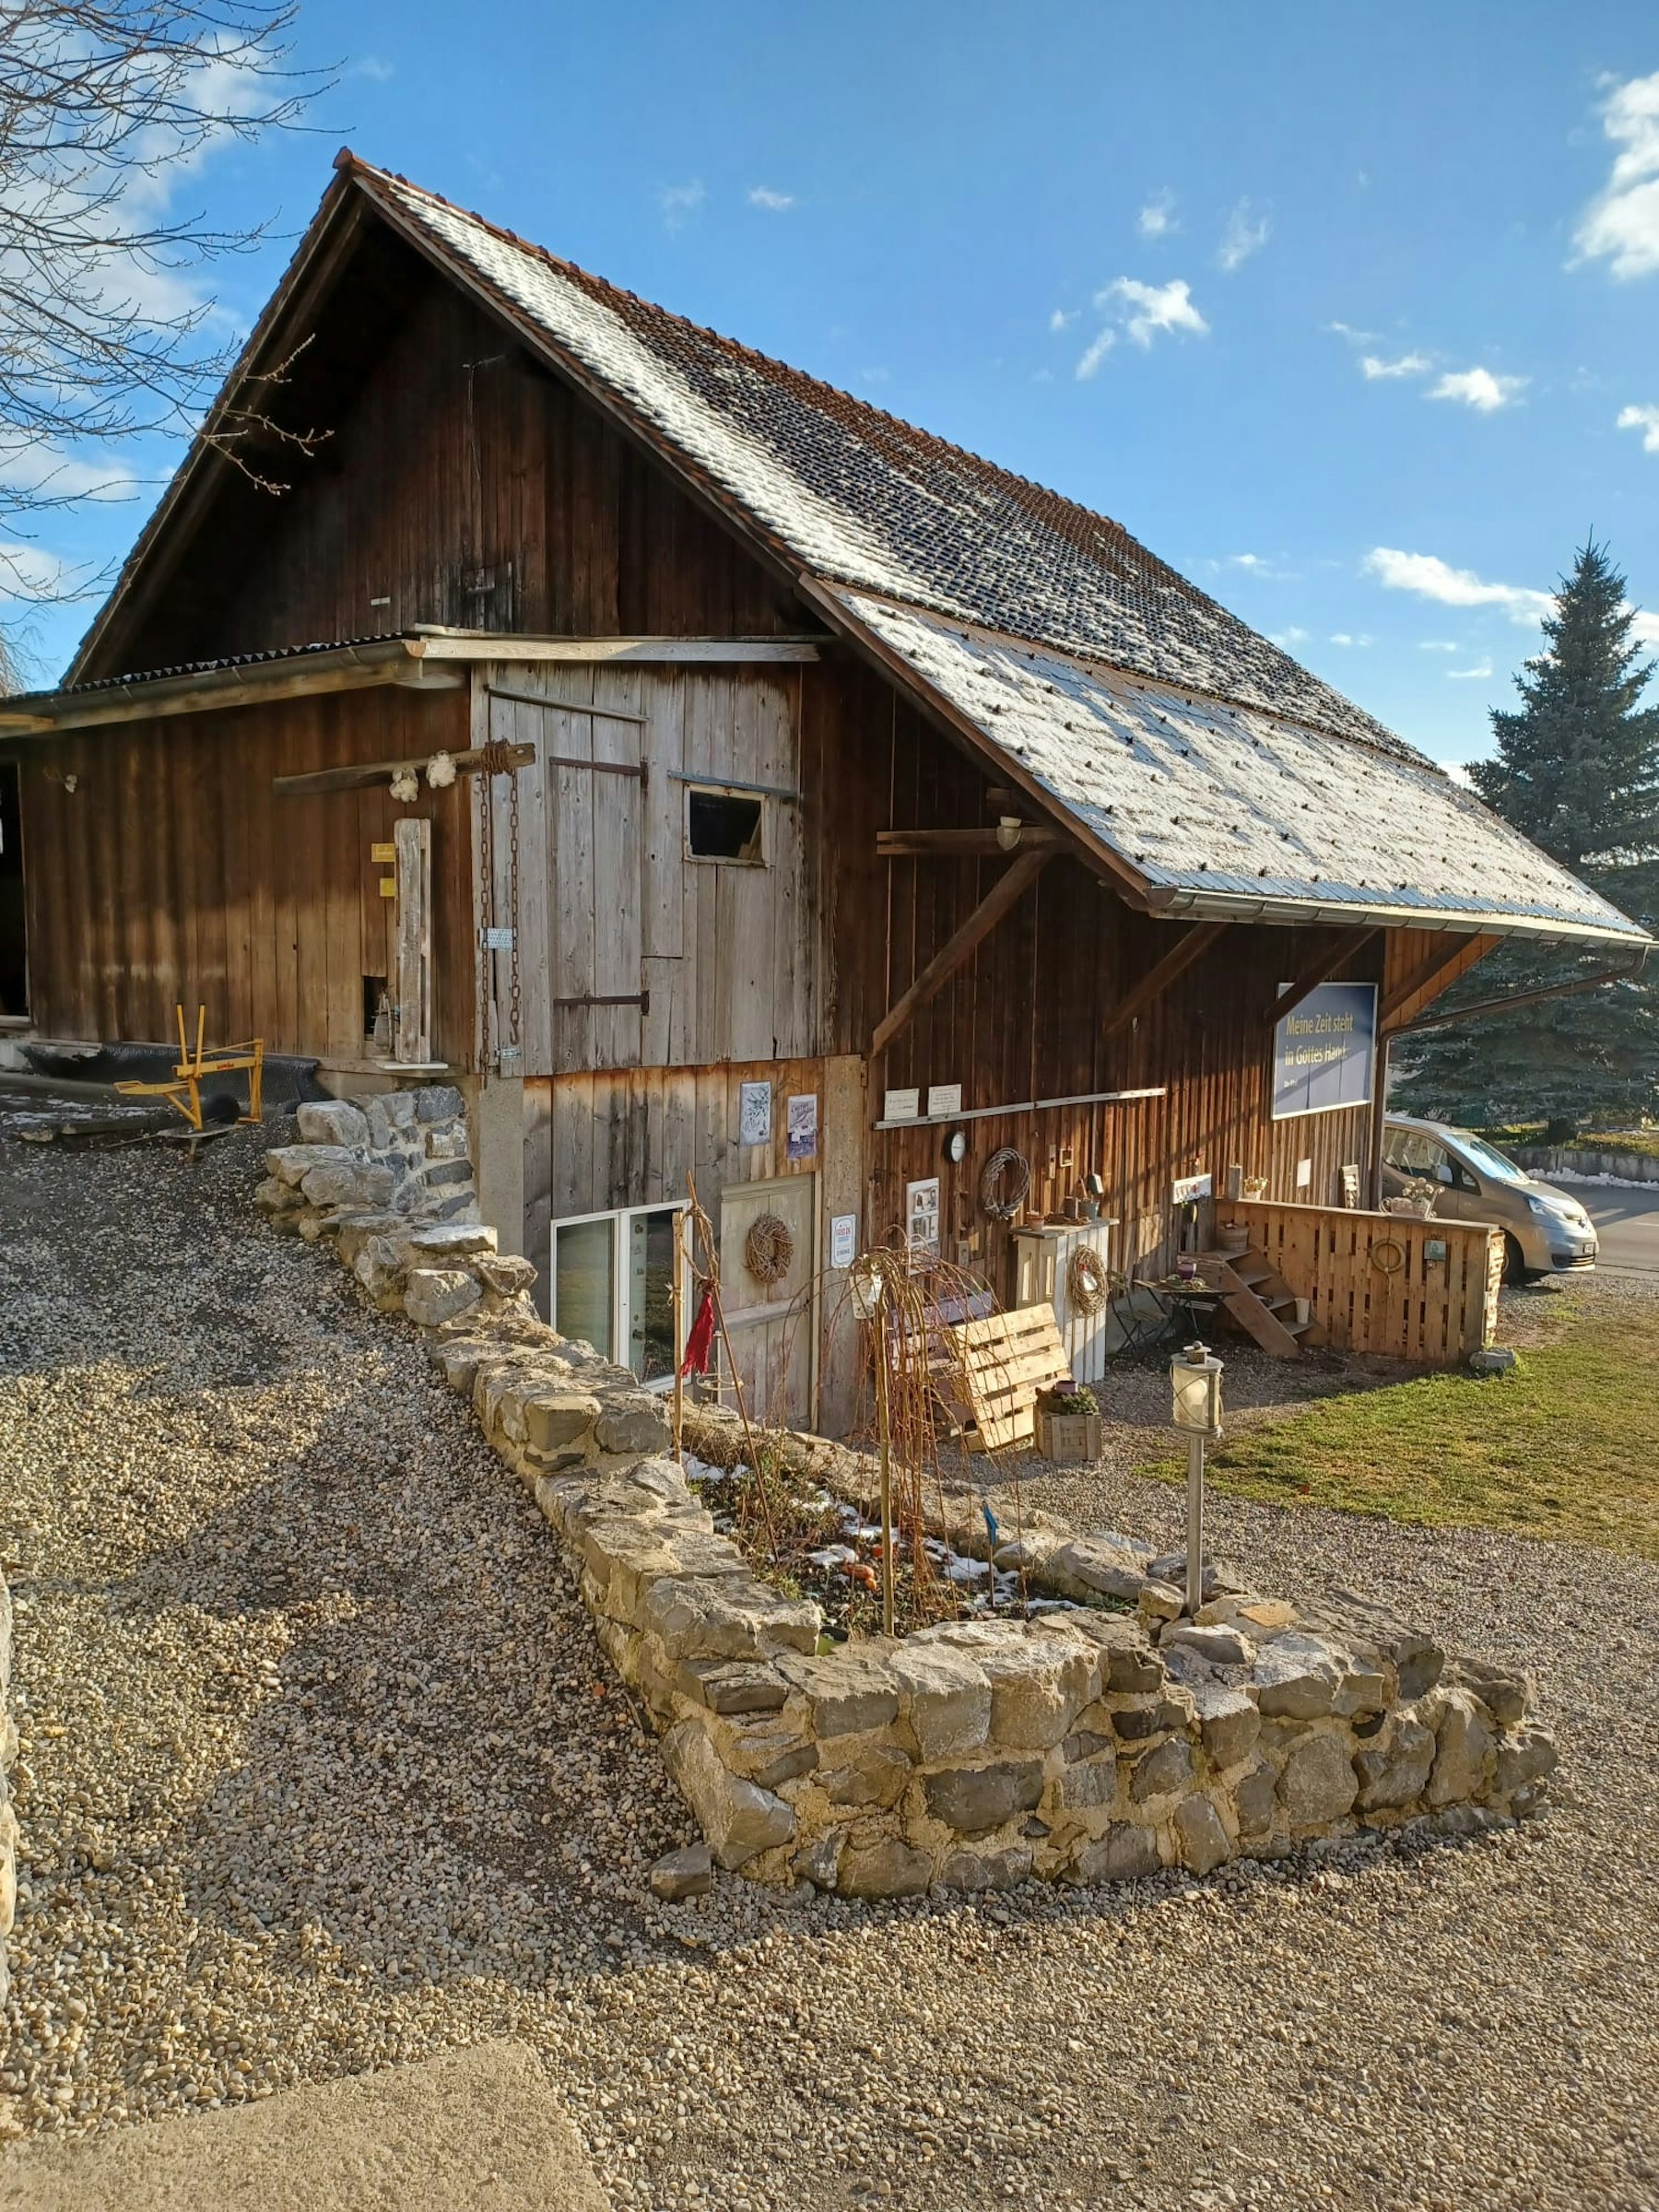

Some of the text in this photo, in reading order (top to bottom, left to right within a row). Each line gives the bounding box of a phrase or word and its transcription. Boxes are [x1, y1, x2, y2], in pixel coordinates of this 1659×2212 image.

[1287, 1011, 1353, 1036] Meine Zeit steht
[1285, 1045, 1294, 1066] in
[1296, 1045, 1324, 1065] Gottes
